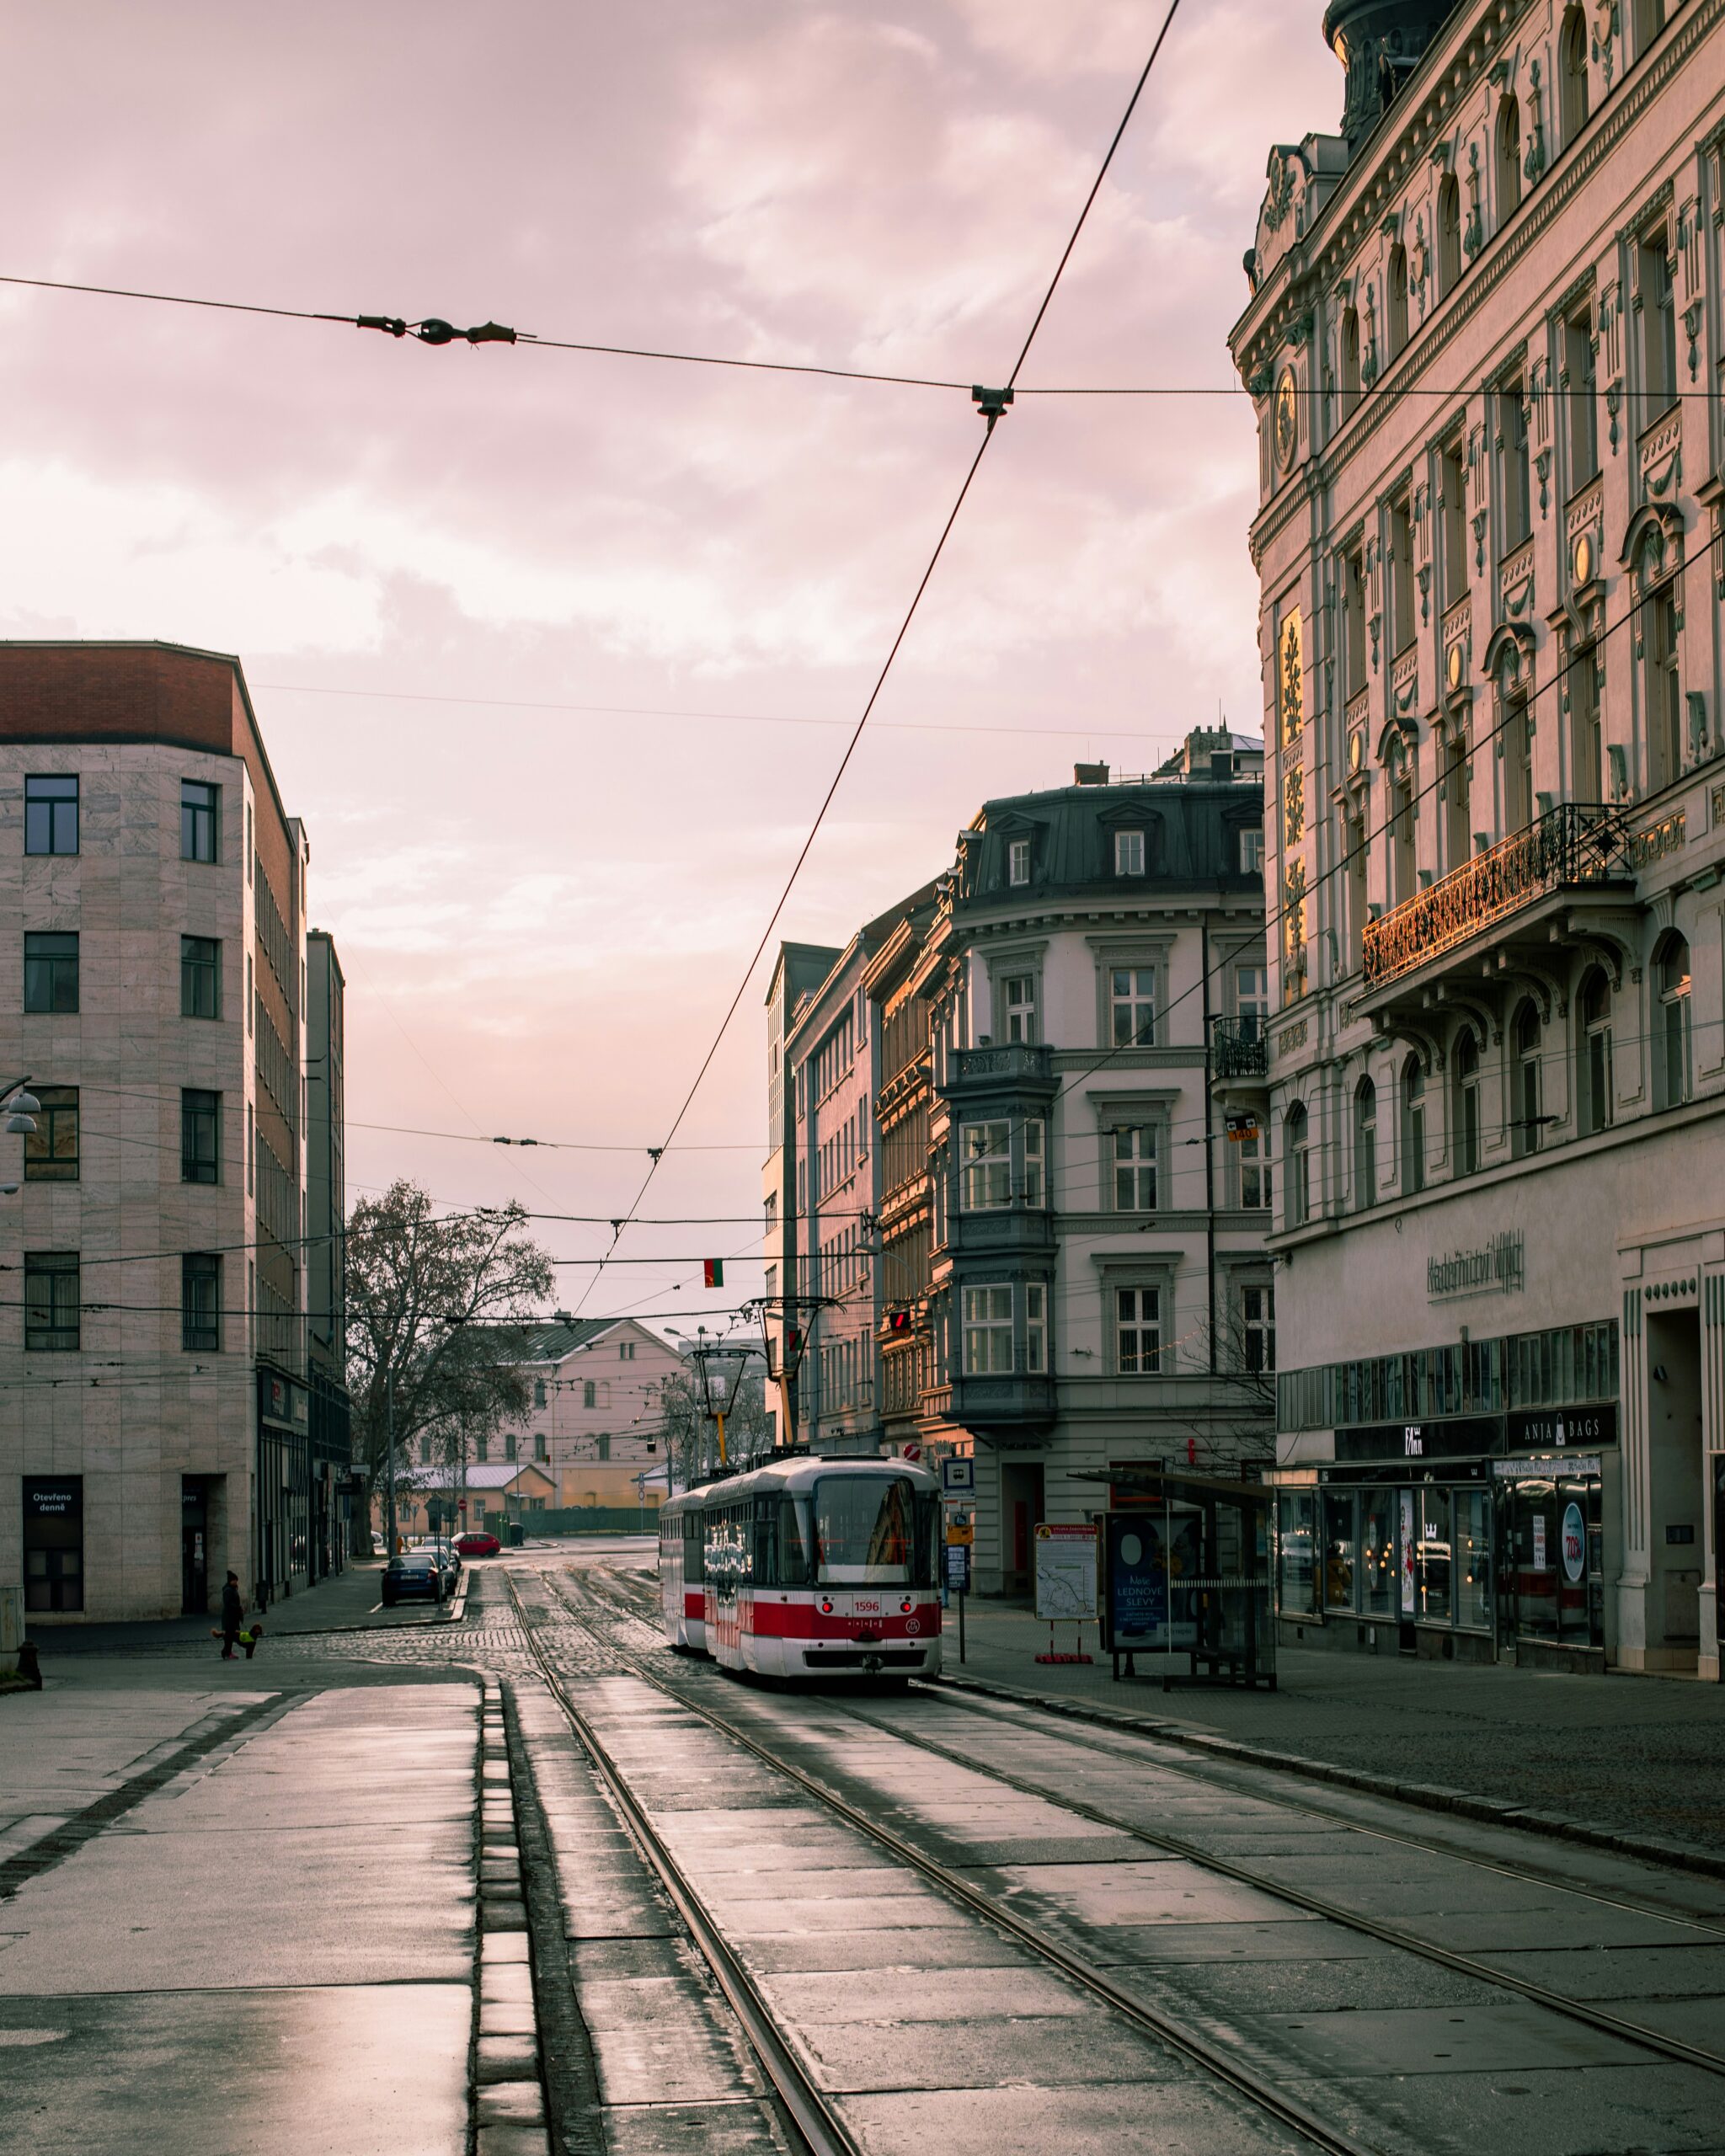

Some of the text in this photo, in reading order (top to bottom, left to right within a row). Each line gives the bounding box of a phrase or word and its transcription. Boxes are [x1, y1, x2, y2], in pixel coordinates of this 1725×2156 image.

[1233, 1129, 1252, 1139] 140
[1525, 1418, 1599, 1441] ANJA BAGS
[33, 1493, 72, 1502] Otevřeno
[40, 1502, 65, 1512] denně
[1566, 1535, 1581, 1561] 70%
[1118, 1585, 1163, 1596] LEDNOVÉ
[855, 1602, 879, 1611] 1596
[1126, 1597, 1155, 1606] SLEVY
